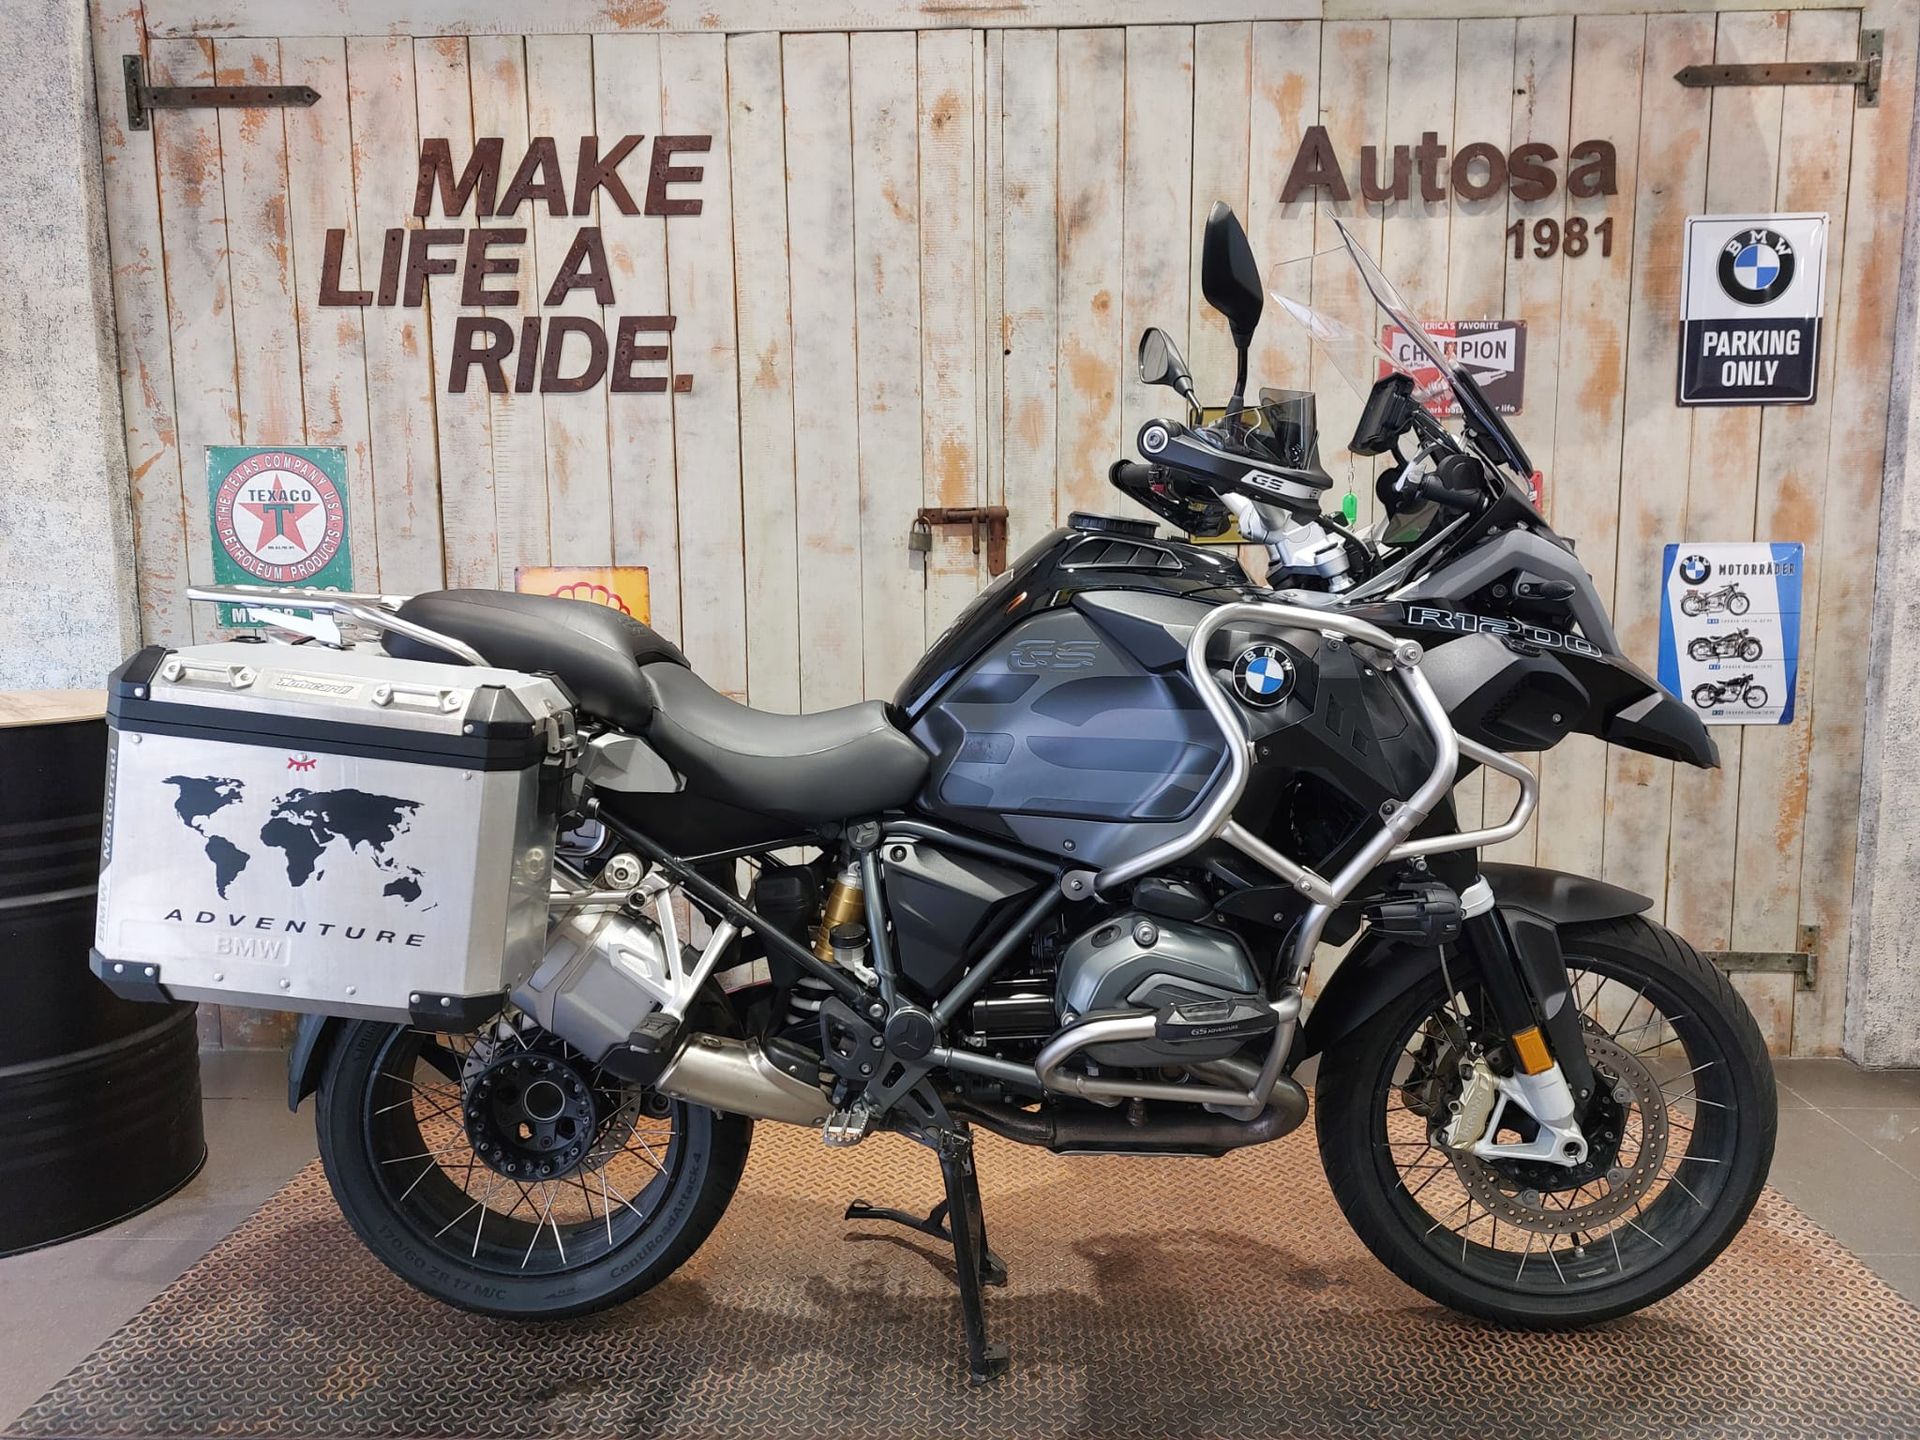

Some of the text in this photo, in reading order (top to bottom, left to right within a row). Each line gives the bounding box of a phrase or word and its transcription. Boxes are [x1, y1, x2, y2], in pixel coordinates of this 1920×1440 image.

[413, 134, 712, 217] MAKE
[1278, 125, 1619, 203] Autosa
[1506, 217, 1614, 260] 1981
[1725, 230, 1793, 257] BMW
[318, 226, 616, 307] LIFE A
[1422, 321, 1499, 331] ERICA'S FAVORITE
[447, 315, 694, 393] RIDE.
[1400, 340, 1507, 361] CHPION
[1702, 329, 1801, 357] PARKING
[1721, 360, 1779, 387] ONLY
[223, 459, 259, 495] TEXAS
[264, 455, 327, 487] COMPANY
[1252, 473, 1285, 491] GS
[218, 494, 231, 522] THE
[248, 489, 312, 502] TEXACO
[221, 528, 340, 580] PETROLEUM PRODUCTS
[1407, 606, 1602, 658] R1200
[1007, 640, 1100, 671] GS
[1243, 647, 1293, 671] BMW
[98, 747, 118, 942] BMW Motorrad
[164, 908, 426, 948] ADVENTURE
[215, 936, 284, 960] BMW
